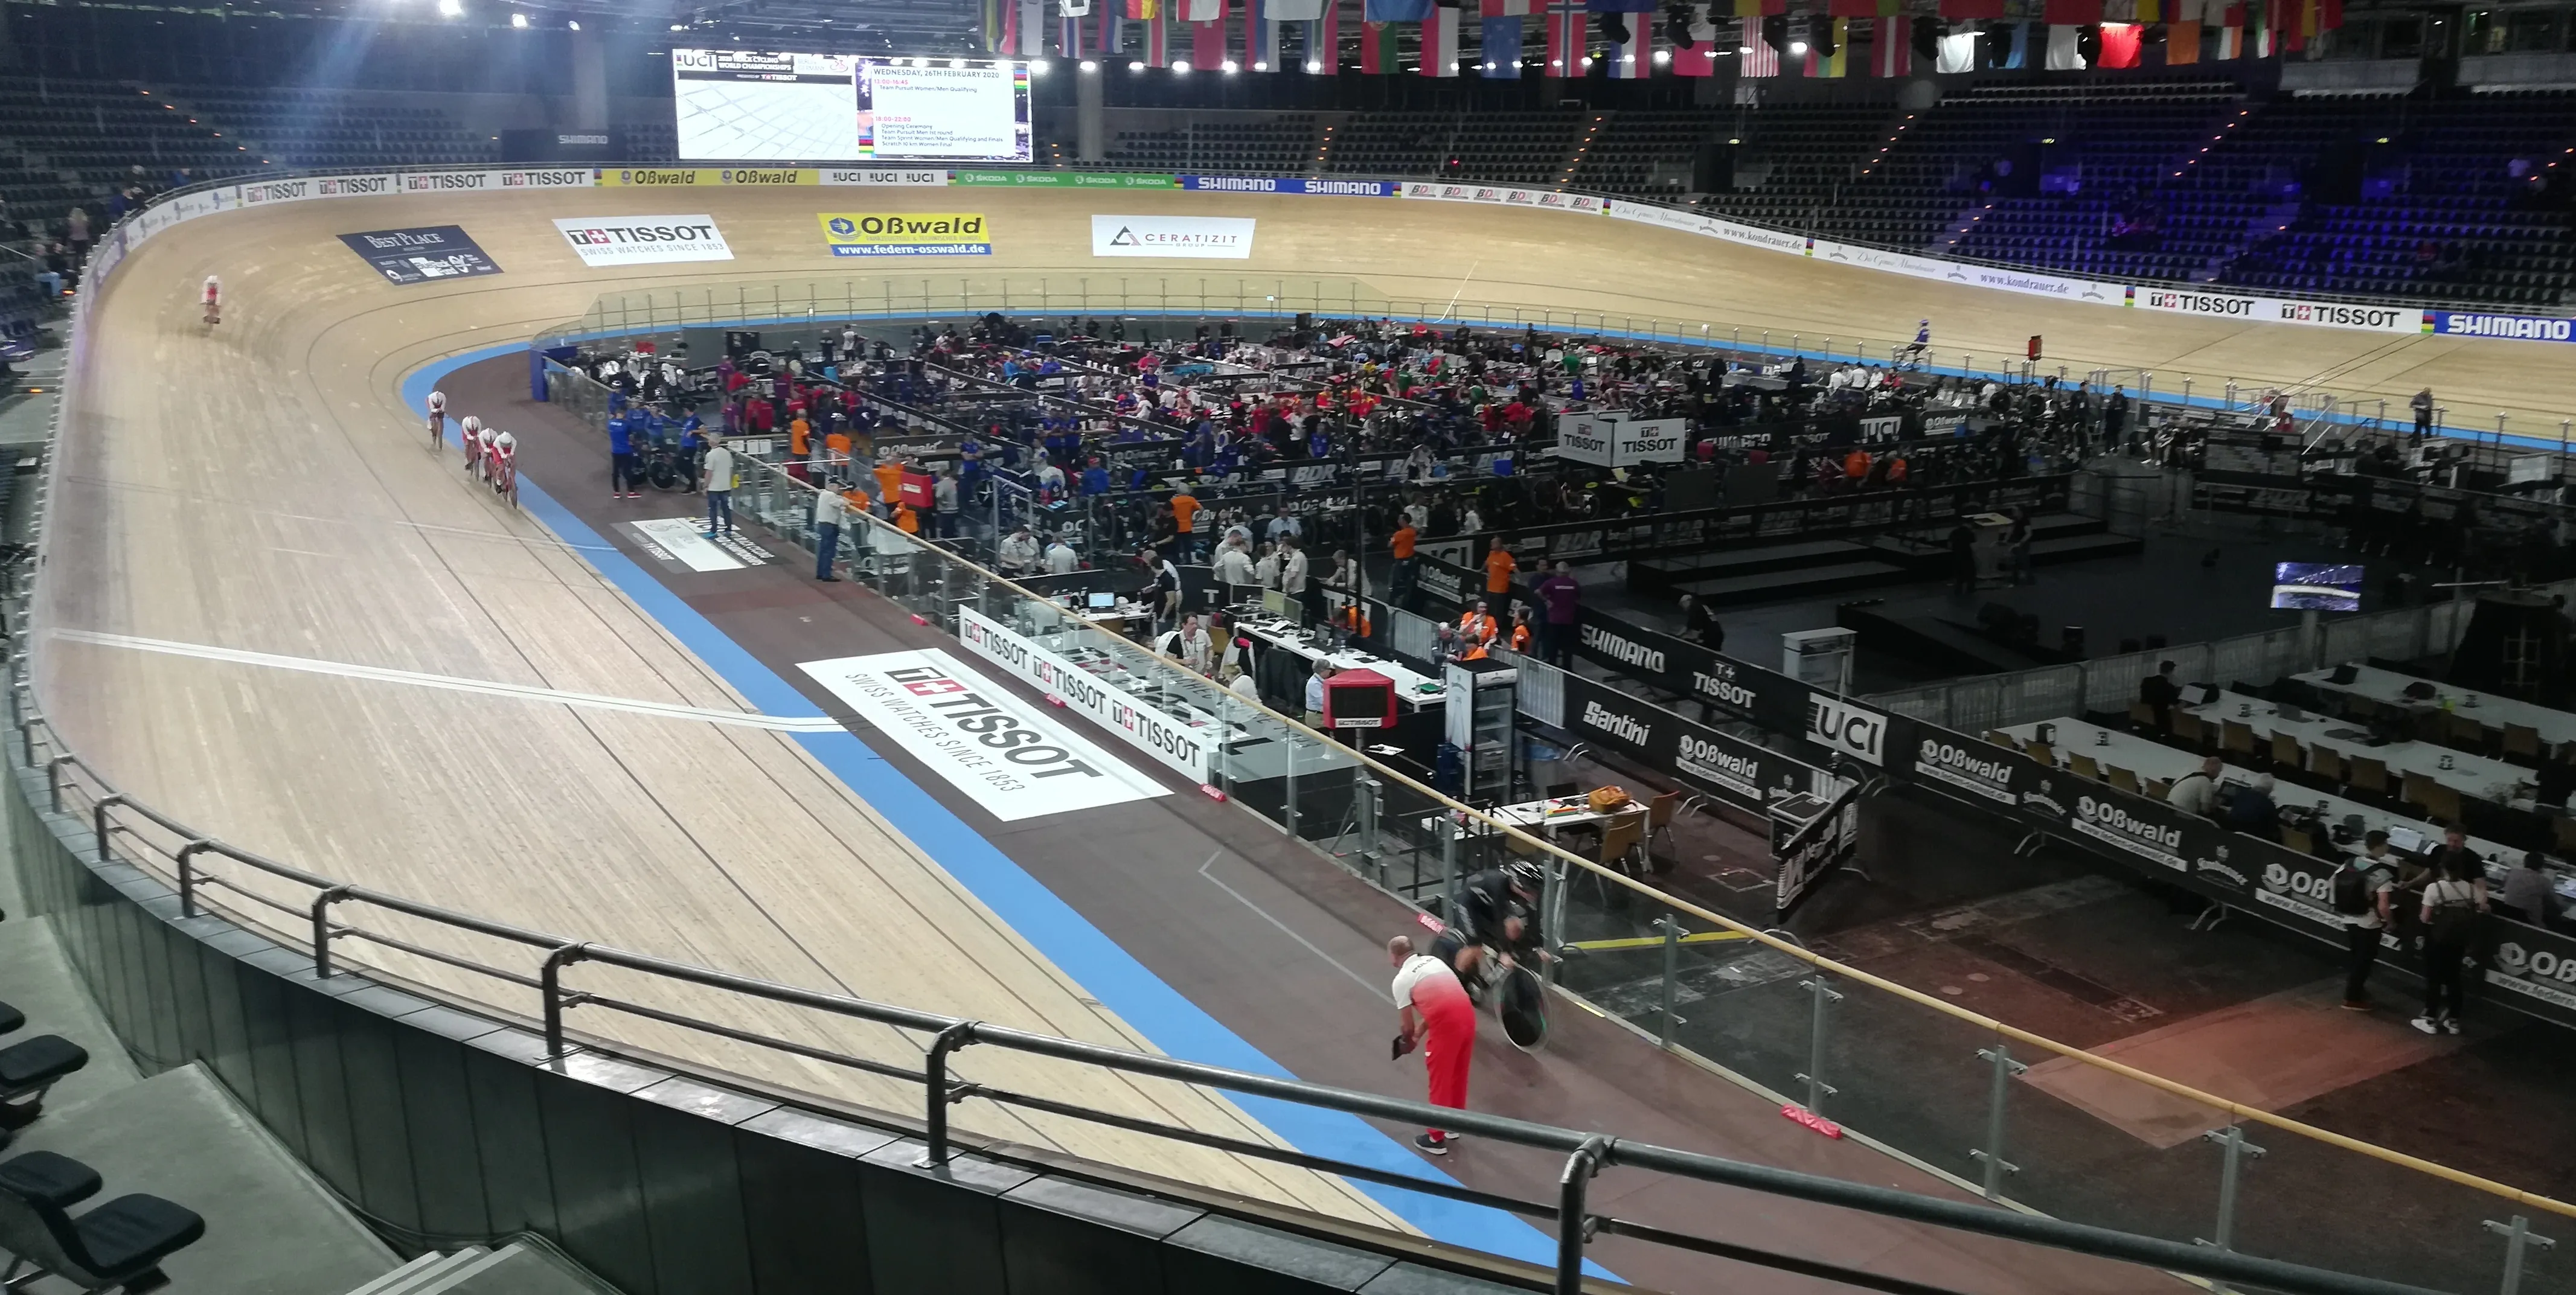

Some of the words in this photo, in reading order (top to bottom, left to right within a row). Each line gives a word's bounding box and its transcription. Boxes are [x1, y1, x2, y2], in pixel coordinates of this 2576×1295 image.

[684, 55, 713, 67] UCI
[559, 135, 607, 144] SHIMANO
[338, 177, 388, 193] TISSOT
[430, 174, 486, 189] TISSOT
[526, 171, 586, 185] TISSOT
[635, 171, 696, 185] Oßwald
[735, 171, 797, 184] Oßwald
[836, 172, 860, 182] UCI
[873, 173, 898, 182] UCI
[910, 173, 934, 183] UCI
[1198, 177, 1276, 191] SHIMANO
[264, 182, 307, 200] TISSOT
[1305, 181, 1382, 195] SHIMANO
[606, 225, 714, 243] TISSOT
[861, 217, 981, 234] Oßwald
[364, 235, 398, 248] BEST
[394, 232, 445, 245] PLACE
[1145, 234, 1237, 244] CERATIZIT
[1723, 227, 1802, 251] www.kondrauer.de
[580, 246, 614, 256] SWISS
[617, 245, 665, 254] WATCHES
[667, 244, 698, 252] SINCE
[701, 242, 724, 251] 1853
[838, 243, 985, 255] www.federn-osswald.de
[1980, 272, 2069, 295] www.kondrauer.de
[2180, 295, 2255, 316] TISSOT
[2315, 306, 2400, 328] TISSOT
[2447, 315, 2571, 340] SHIMANO
[1564, 433, 1605, 453] TISSOT
[1622, 438, 1677, 453] TISSOT
[1292, 464, 1337, 482] BDR
[981, 626, 1028, 669] TISSOT
[1581, 623, 1665, 673] SHIMANO
[1054, 666, 1106, 715] TISSOT
[1693, 671, 1757, 708] TISSOT
[1583, 700, 1651, 746] Santini
[1818, 706, 1880, 755] UCI
[845, 673, 894, 698] SWISS
[881, 699, 949, 739] WATCHES
[936, 740, 993, 769] SINCE
[979, 769, 1025, 792] 1853
[929, 693, 1104, 779] TISSOT
[1135, 711, 1200, 767] TISSOT
[1695, 740, 1758, 779] Oßwald
[1940, 744, 2014, 784] Oßwald
[2098, 803, 2182, 848] Oßwald
